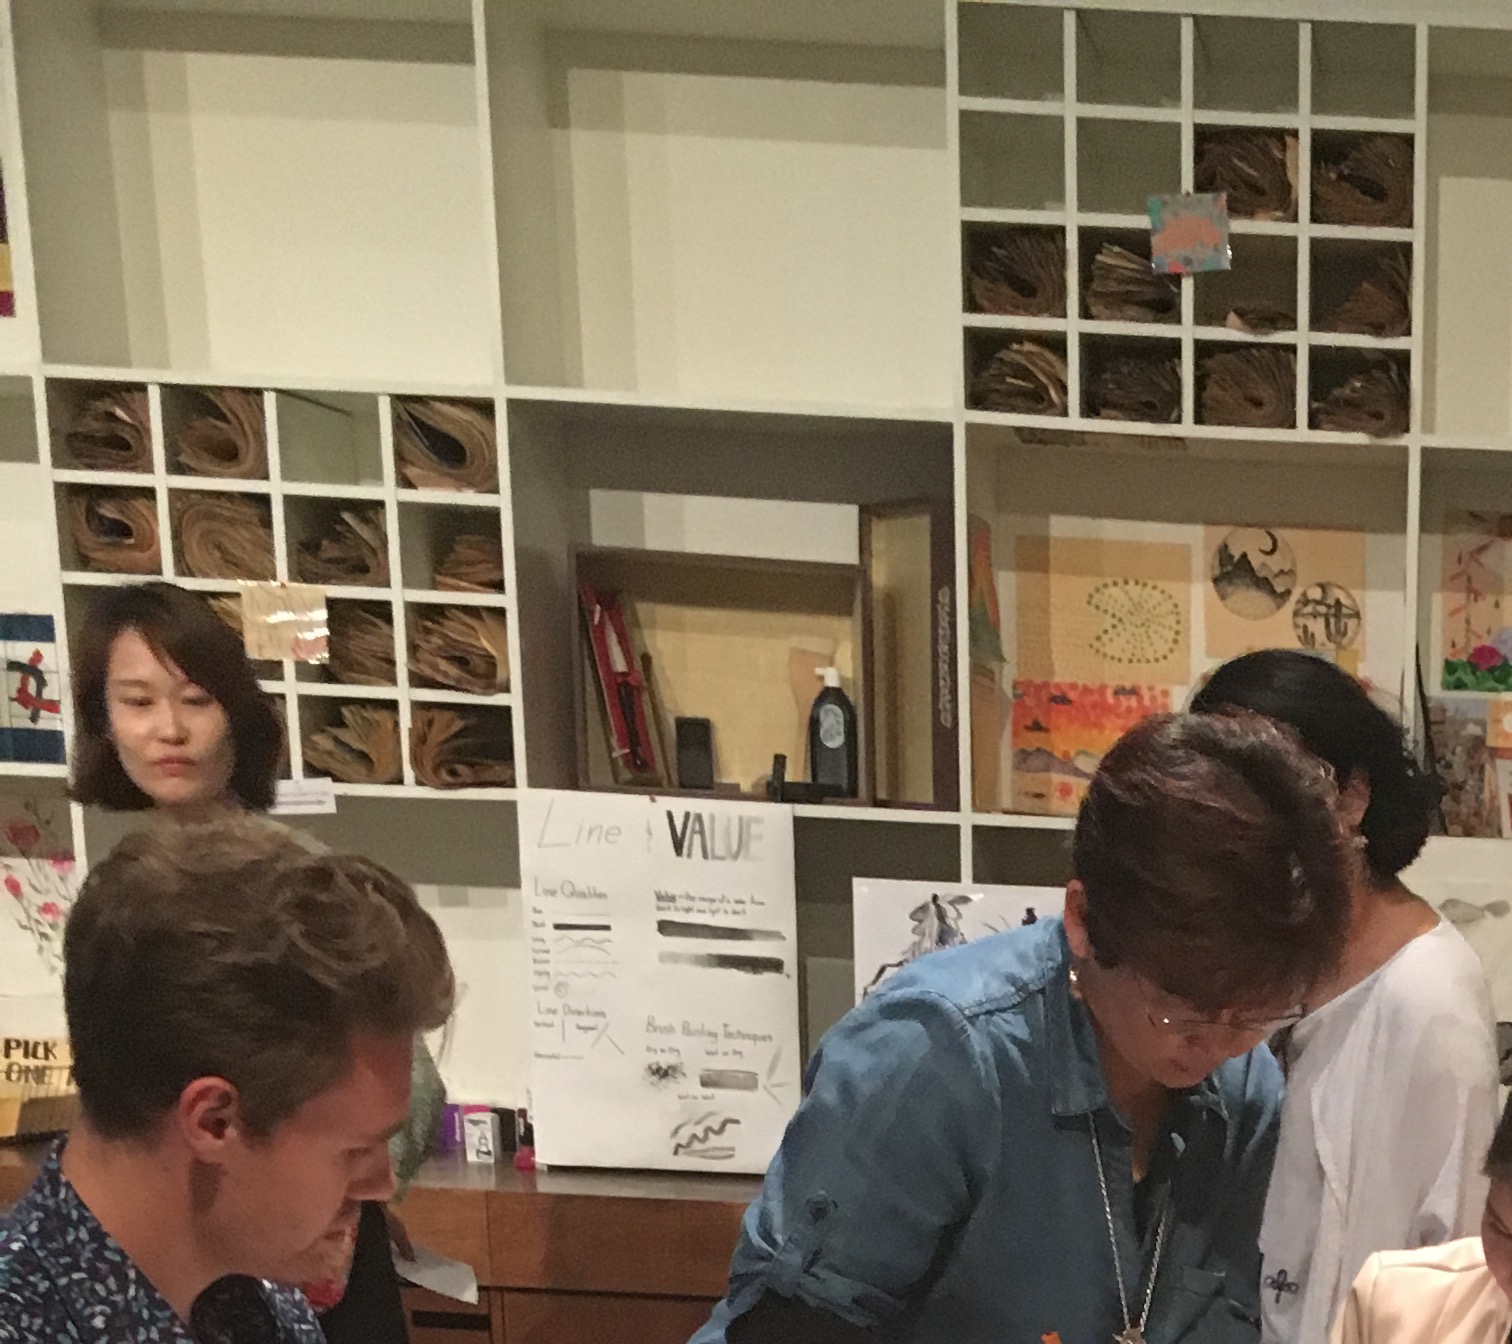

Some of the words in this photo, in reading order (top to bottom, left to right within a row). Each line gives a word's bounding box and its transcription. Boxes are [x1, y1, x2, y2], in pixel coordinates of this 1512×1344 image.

[537, 797, 622, 849] Line
[666, 809, 765, 862] VALUE
[4, 1037, 58, 1061] PICK
[5, 1062, 54, 1086] ONE
